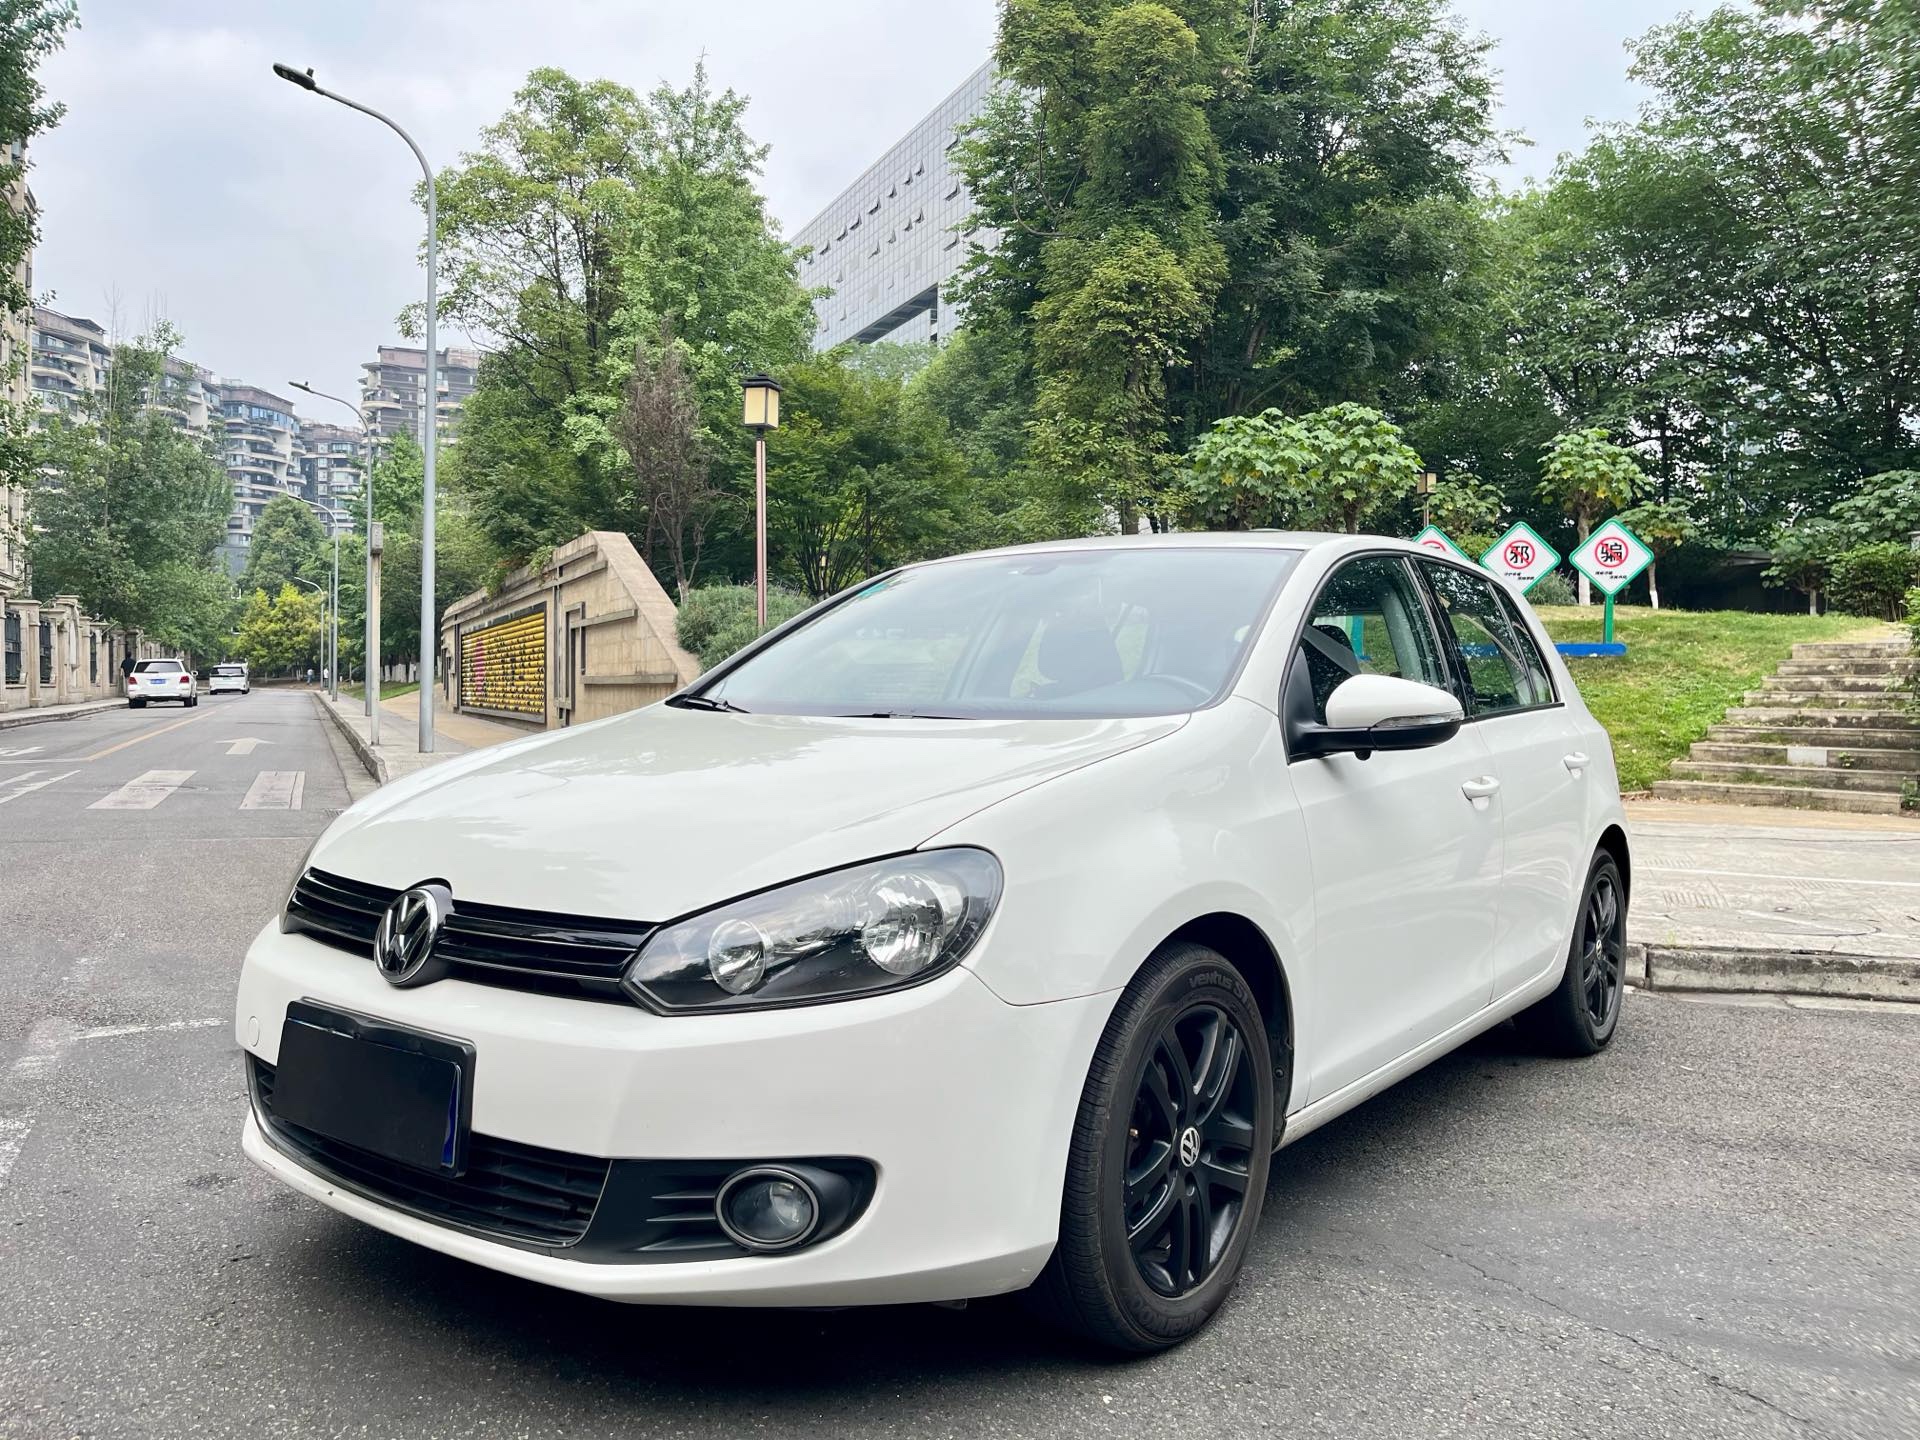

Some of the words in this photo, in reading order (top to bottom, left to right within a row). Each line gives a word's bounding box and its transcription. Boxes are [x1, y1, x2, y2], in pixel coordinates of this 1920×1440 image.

[1510, 545, 1530, 563] 邪
[1600, 542, 1622, 562] 骗
[378, 892, 435, 980] VW
